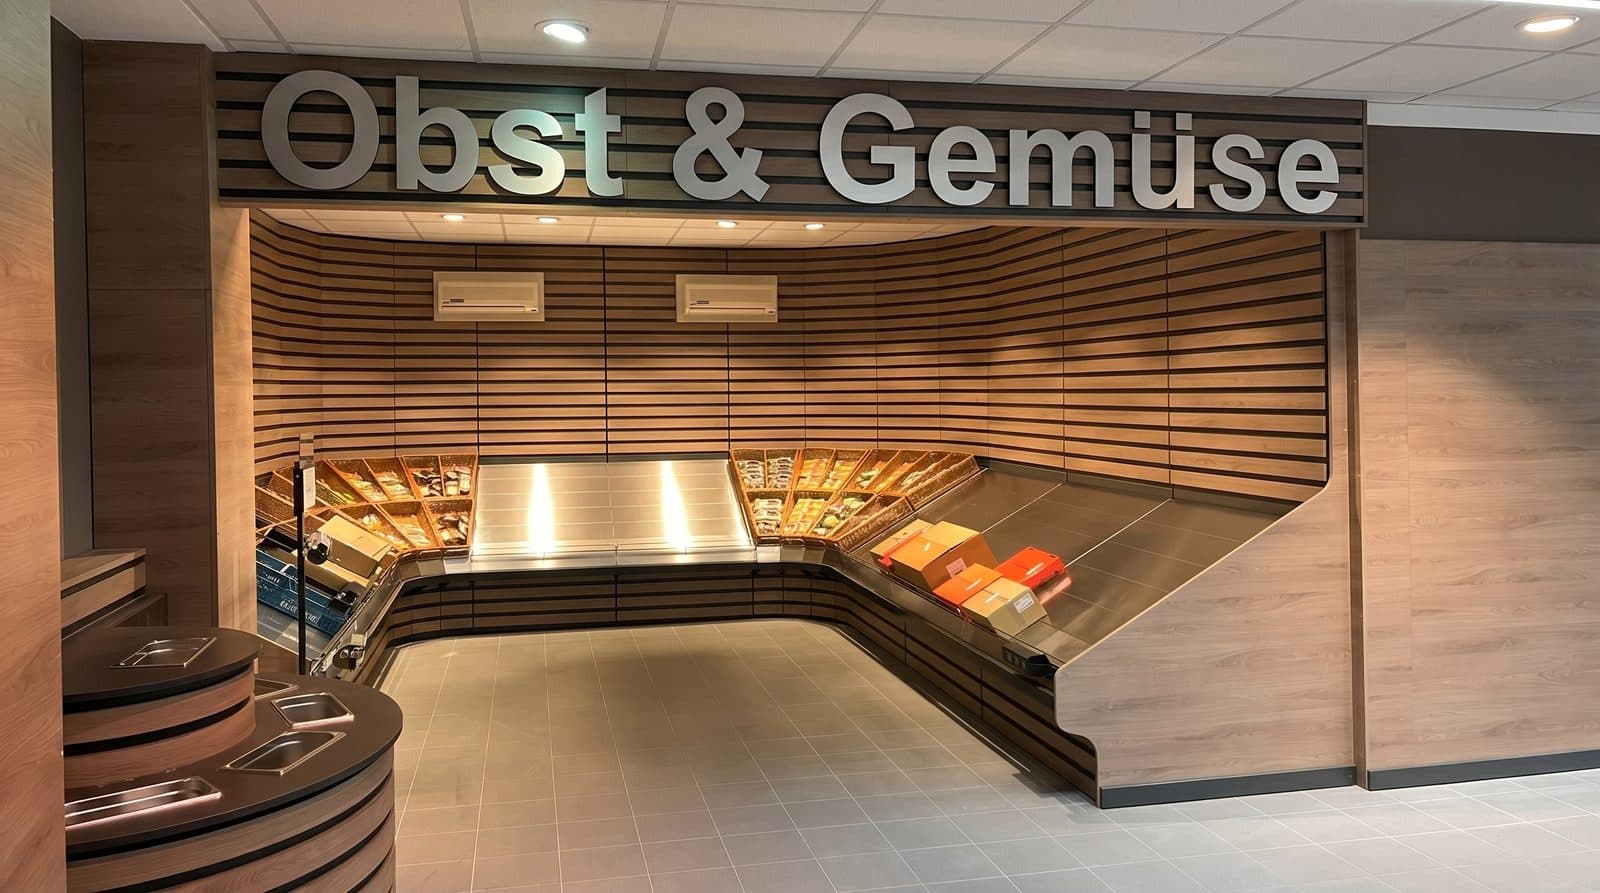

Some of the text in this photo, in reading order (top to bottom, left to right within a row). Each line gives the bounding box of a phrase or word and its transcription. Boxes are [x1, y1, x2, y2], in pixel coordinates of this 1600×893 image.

[261, 69, 1340, 214] Obst & Gemüse
